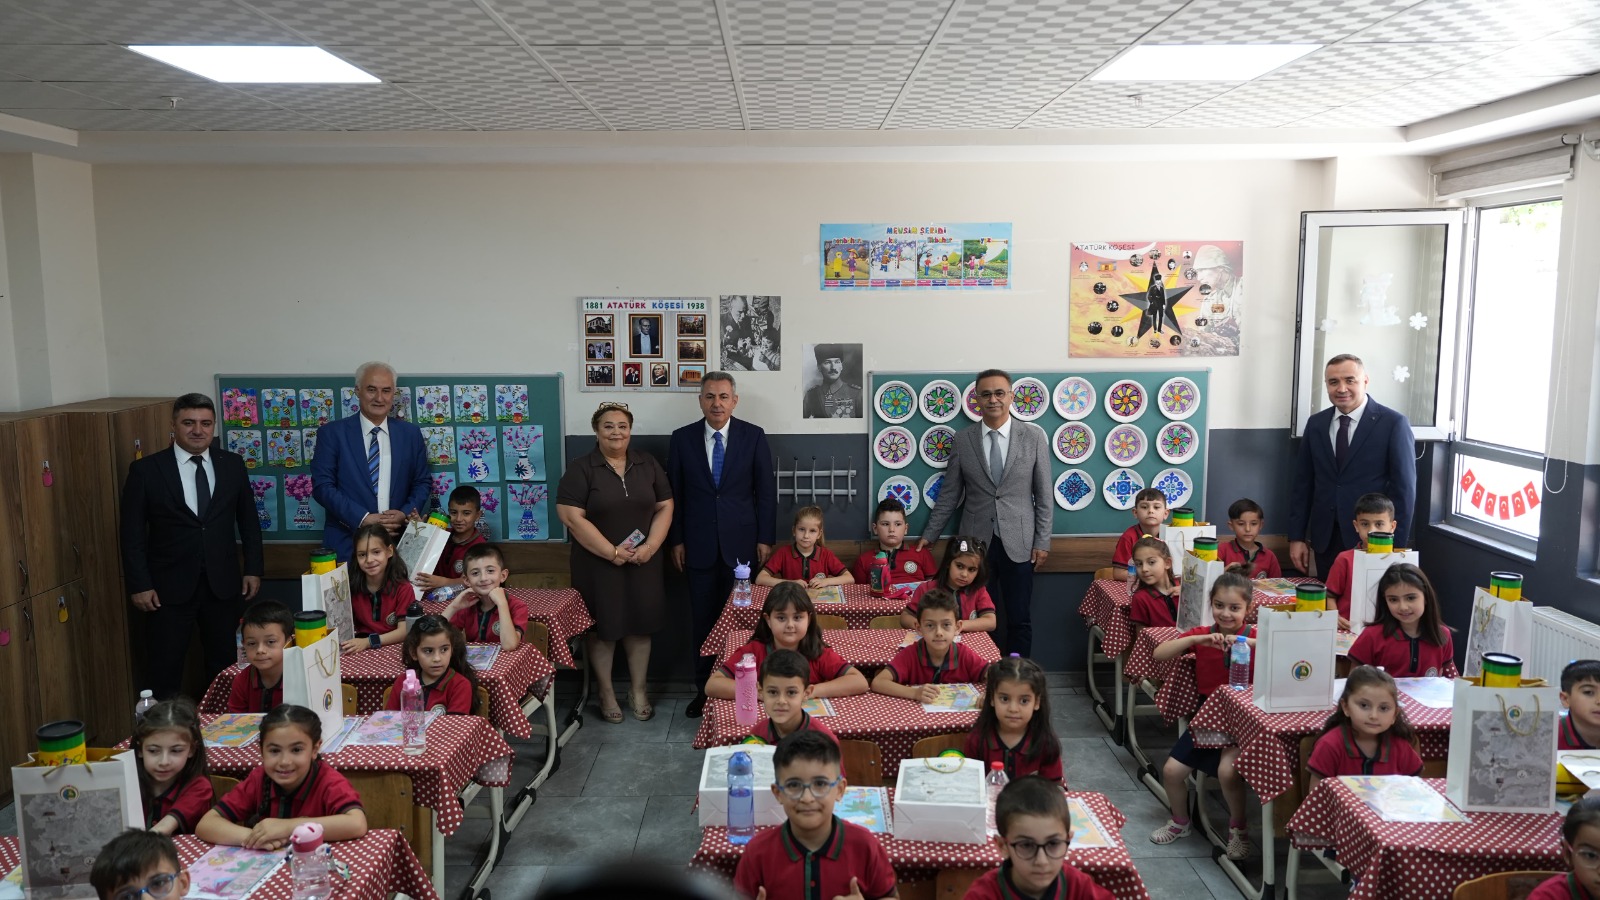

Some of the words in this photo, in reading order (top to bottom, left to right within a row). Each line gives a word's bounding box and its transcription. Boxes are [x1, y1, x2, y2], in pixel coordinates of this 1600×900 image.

[585, 301, 603, 310] 1881
[607, 300, 646, 309] ATATÜRK
[652, 300, 684, 311] KÖŞESİ
[687, 302, 705, 310] 1938
